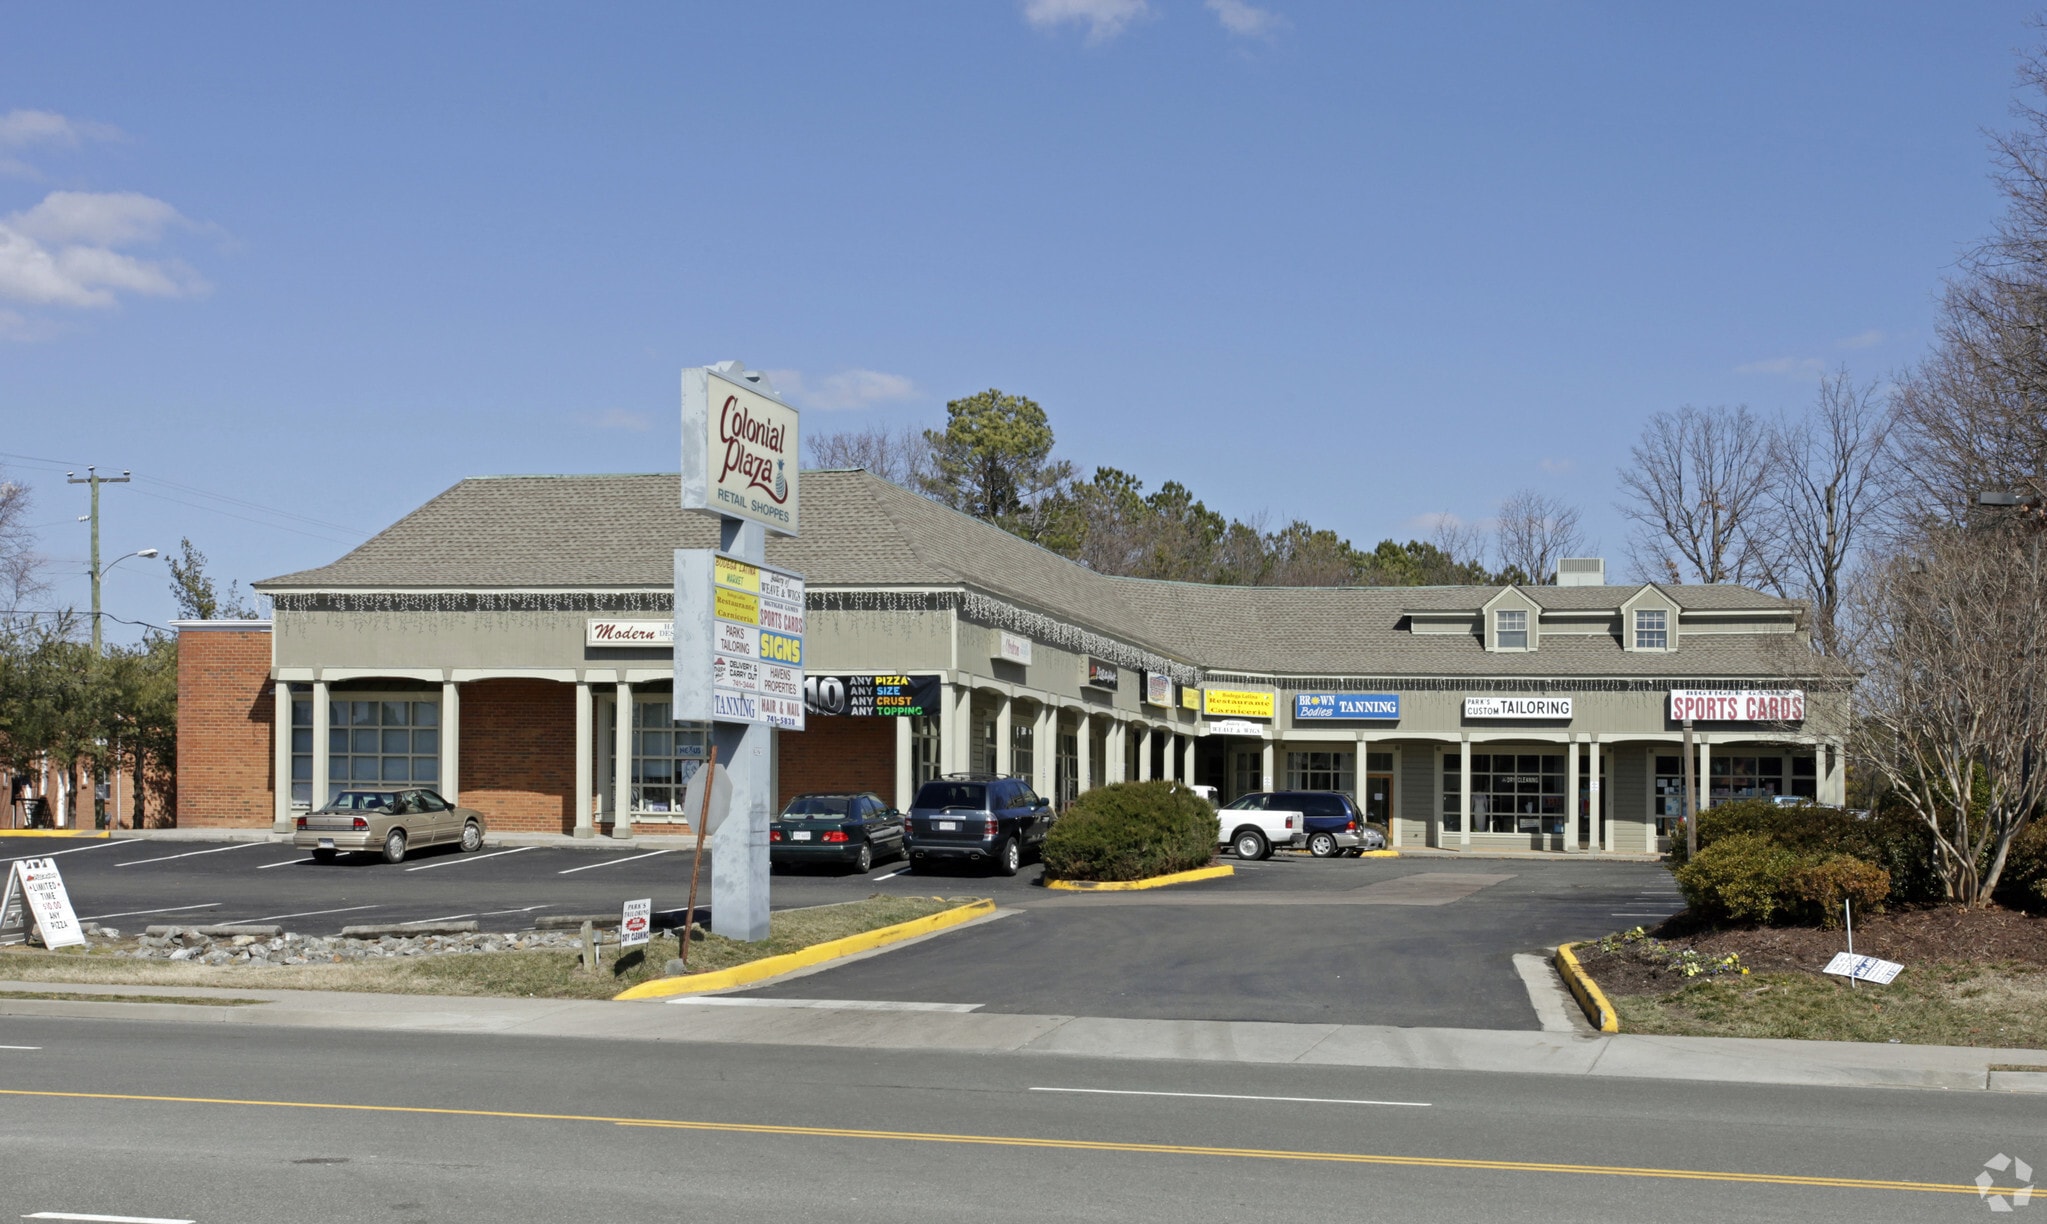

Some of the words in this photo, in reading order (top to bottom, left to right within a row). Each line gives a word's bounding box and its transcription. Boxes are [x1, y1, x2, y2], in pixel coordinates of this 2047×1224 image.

[720, 395, 785, 454] Colonial
[718, 436, 788, 504] Plaza
[718, 488, 748, 509] RETAIL
[751, 501, 790, 523] SHOPPES
[761, 581, 780, 597] WEAVE
[787, 588, 801, 602] WIGS
[716, 596, 756, 612] Restaurante
[760, 608, 782, 630] SPORTS
[783, 613, 803, 633] CARDS
[594, 623, 655, 640] Modern
[725, 625, 745, 640] PARKS
[720, 638, 750, 655] TAILORING
[761, 633, 800, 663] SIGNS
[729, 660, 752, 671] DELIVERY
[729, 668, 746, 680] CARRY
[747, 672, 758, 681] OUT
[770, 667, 791, 681] HAVENS
[850, 677, 872, 686] ANY
[875, 676, 908, 686] PIZZA
[764, 679, 797, 696] PROPERTIES
[850, 687, 872, 696] ANY
[876, 686, 901, 696] SIZE
[715, 695, 755, 718] TANNING
[761, 697, 776, 713] HAIR
[786, 701, 800, 718] NAIL
[851, 697, 873, 706] ANY
[876, 696, 912, 706] CRUST
[1209, 698, 1270, 707] Restaurante
[1339, 701, 1396, 713] TANNING
[1500, 700, 1570, 715] TAILORING
[851, 707, 873, 716] ANY
[876, 706, 923, 716] TOPPING
[1210, 707, 1268, 716] Carniceria
[1300, 706, 1333, 717] Bodies
[1467, 707, 1500, 716] CUSTOM
[1673, 697, 1738, 720] SPORTS
[1746, 697, 1803, 720] CARDS
[32, 881, 57, 892] LIMITED
[40, 892, 56, 901] TIME
[49, 912, 60, 920] ANY
[51, 921, 67, 929] PIZZA
